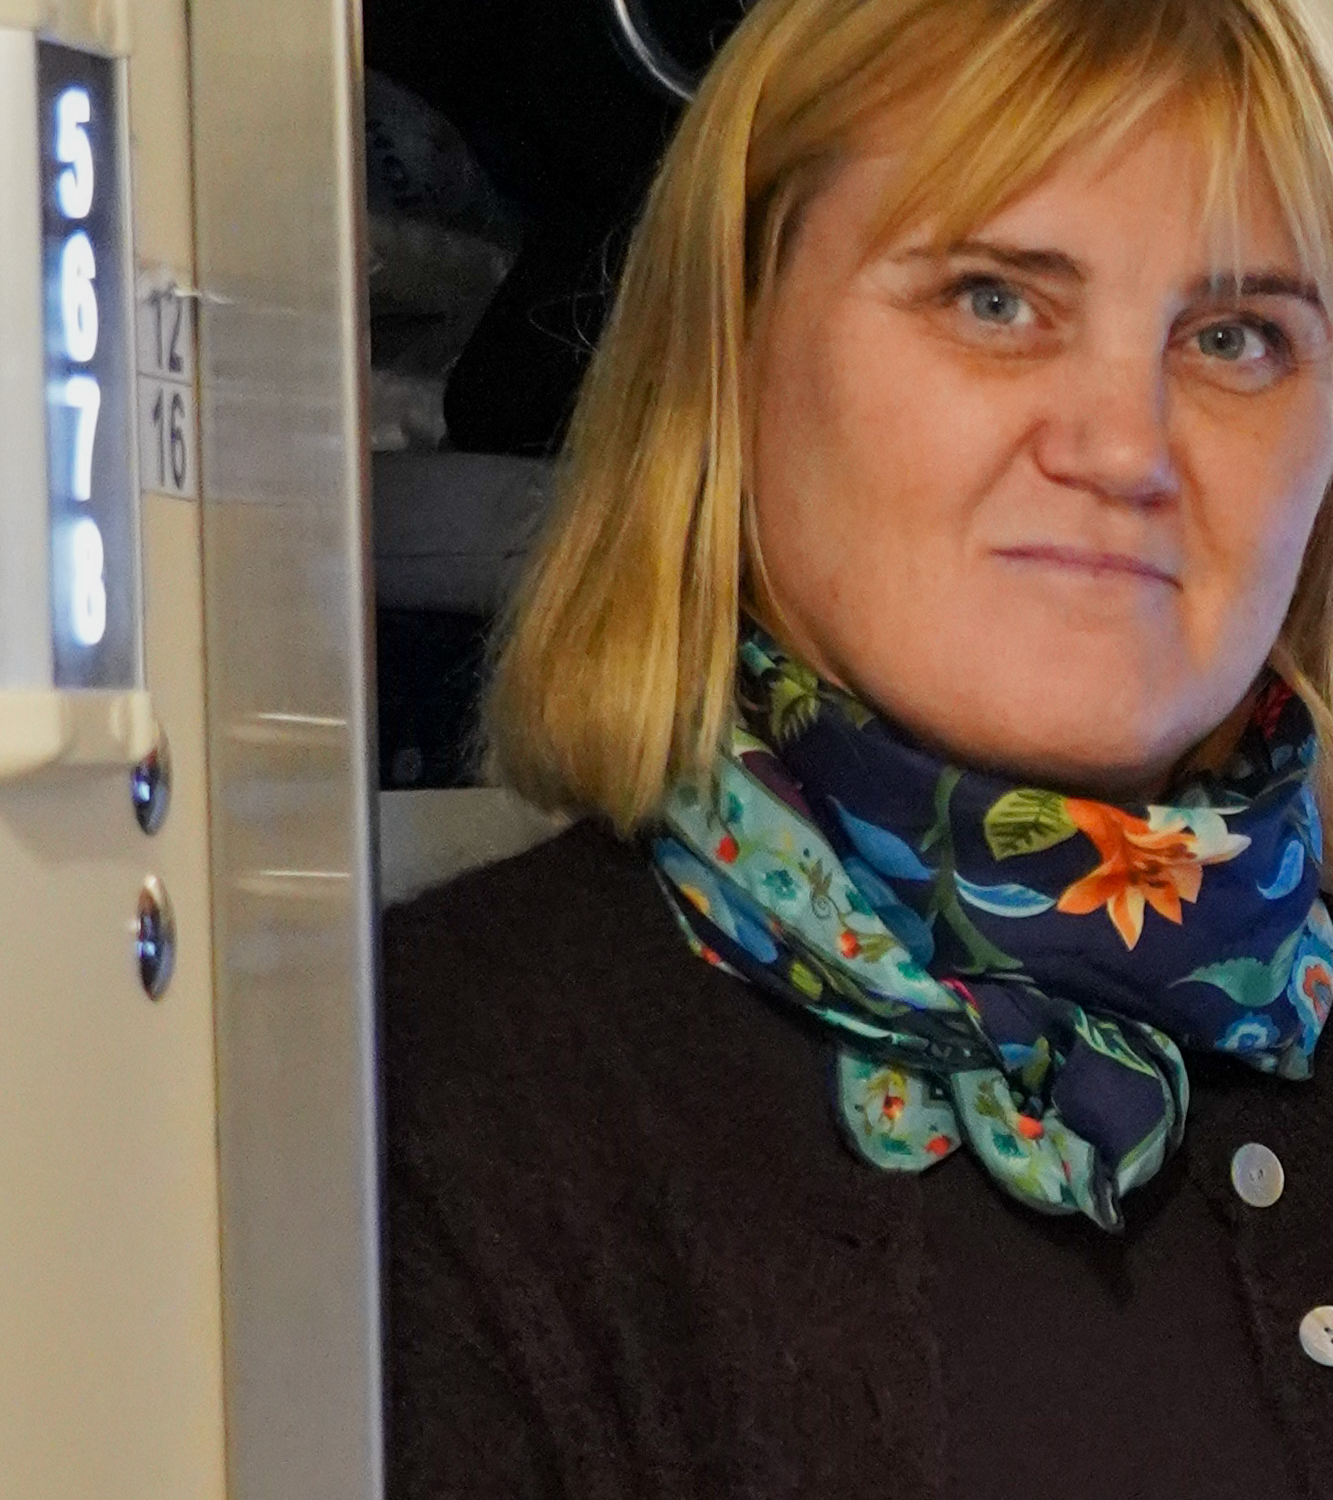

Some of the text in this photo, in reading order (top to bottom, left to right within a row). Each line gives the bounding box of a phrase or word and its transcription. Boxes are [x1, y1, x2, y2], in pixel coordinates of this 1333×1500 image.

[56, 87, 94, 220] 5
[62, 230, 99, 362] 6
[149, 283, 184, 373] 12
[61, 376, 101, 502] 7
[153, 388, 187, 490] 16
[72, 518, 106, 646] 8
